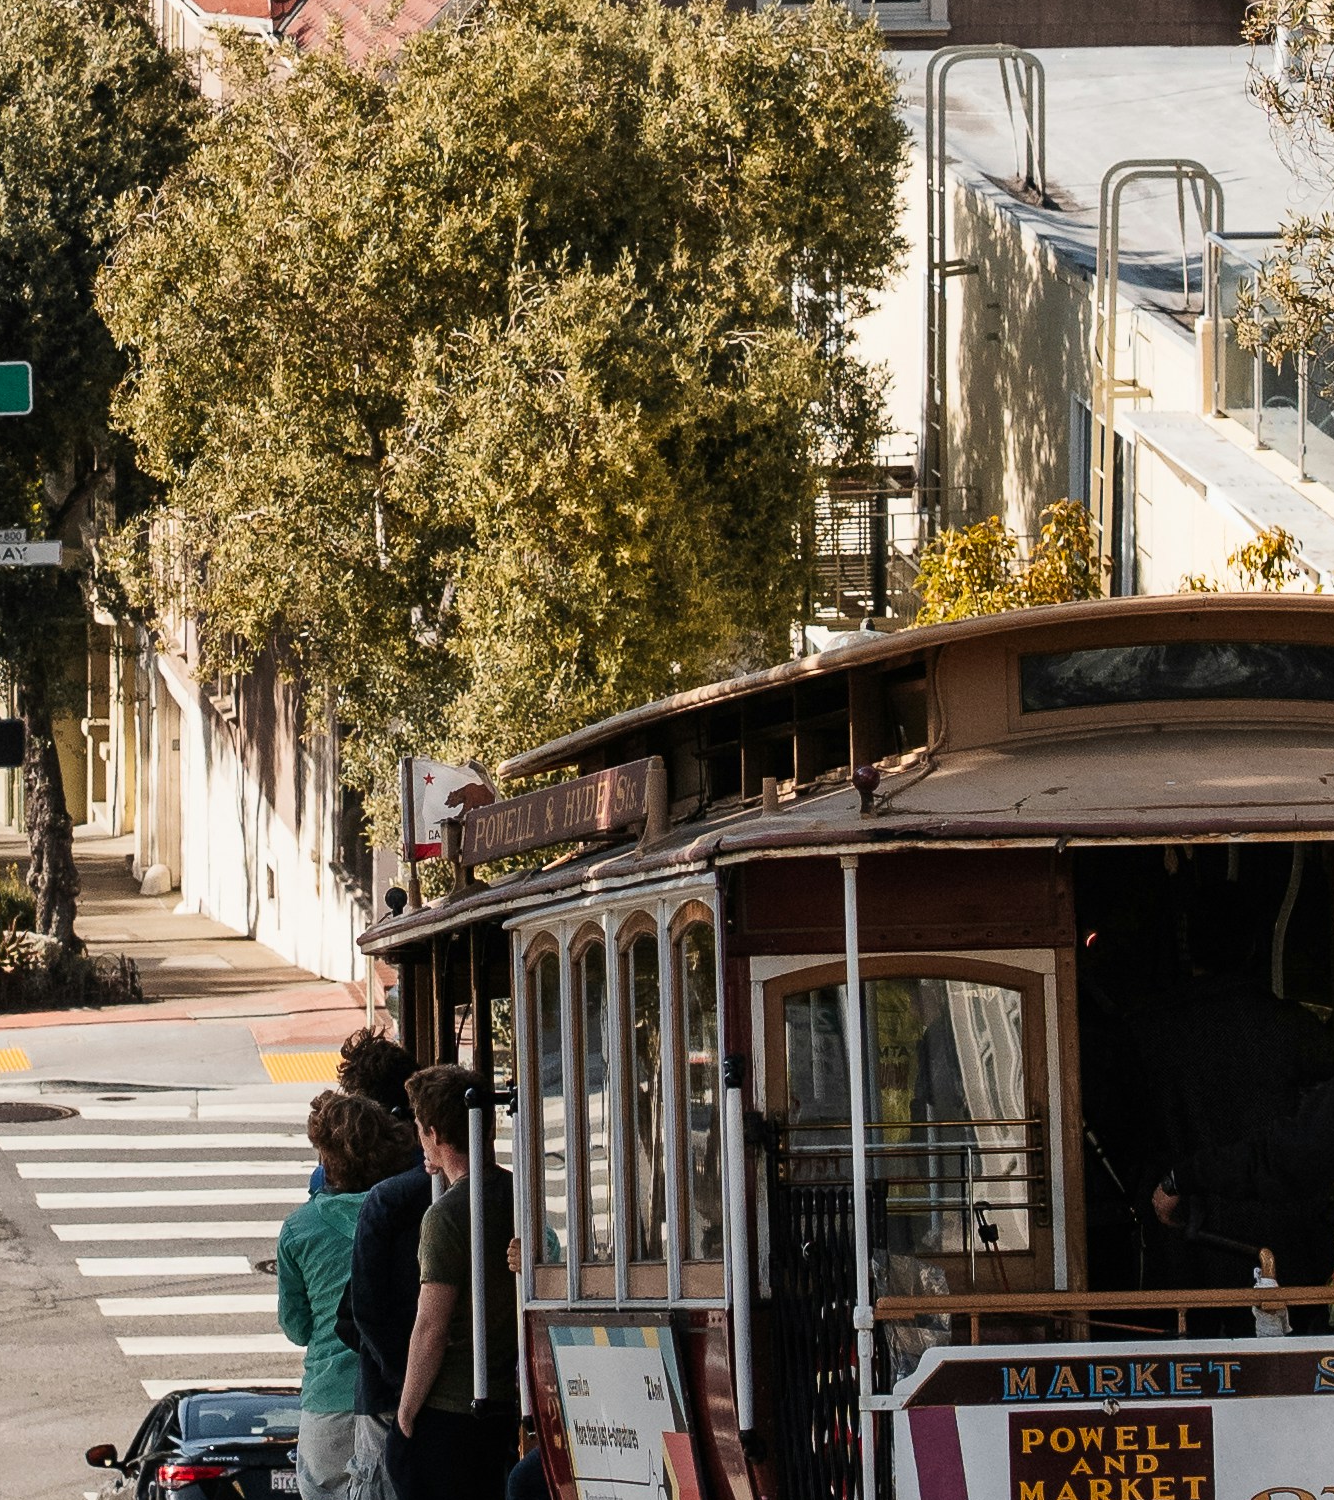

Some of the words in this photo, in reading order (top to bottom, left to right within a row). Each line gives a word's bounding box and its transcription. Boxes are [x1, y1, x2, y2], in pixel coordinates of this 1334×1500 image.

[473, 803, 535, 853] POWELL
[545, 795, 555, 835] &
[562, 779, 610, 828] HYDE
[428, 829, 442, 841] CA
[1002, 1361, 1242, 1401] MARKET
[1021, 1424, 1202, 1454] POWELL
[1070, 1454, 1159, 1476] AND
